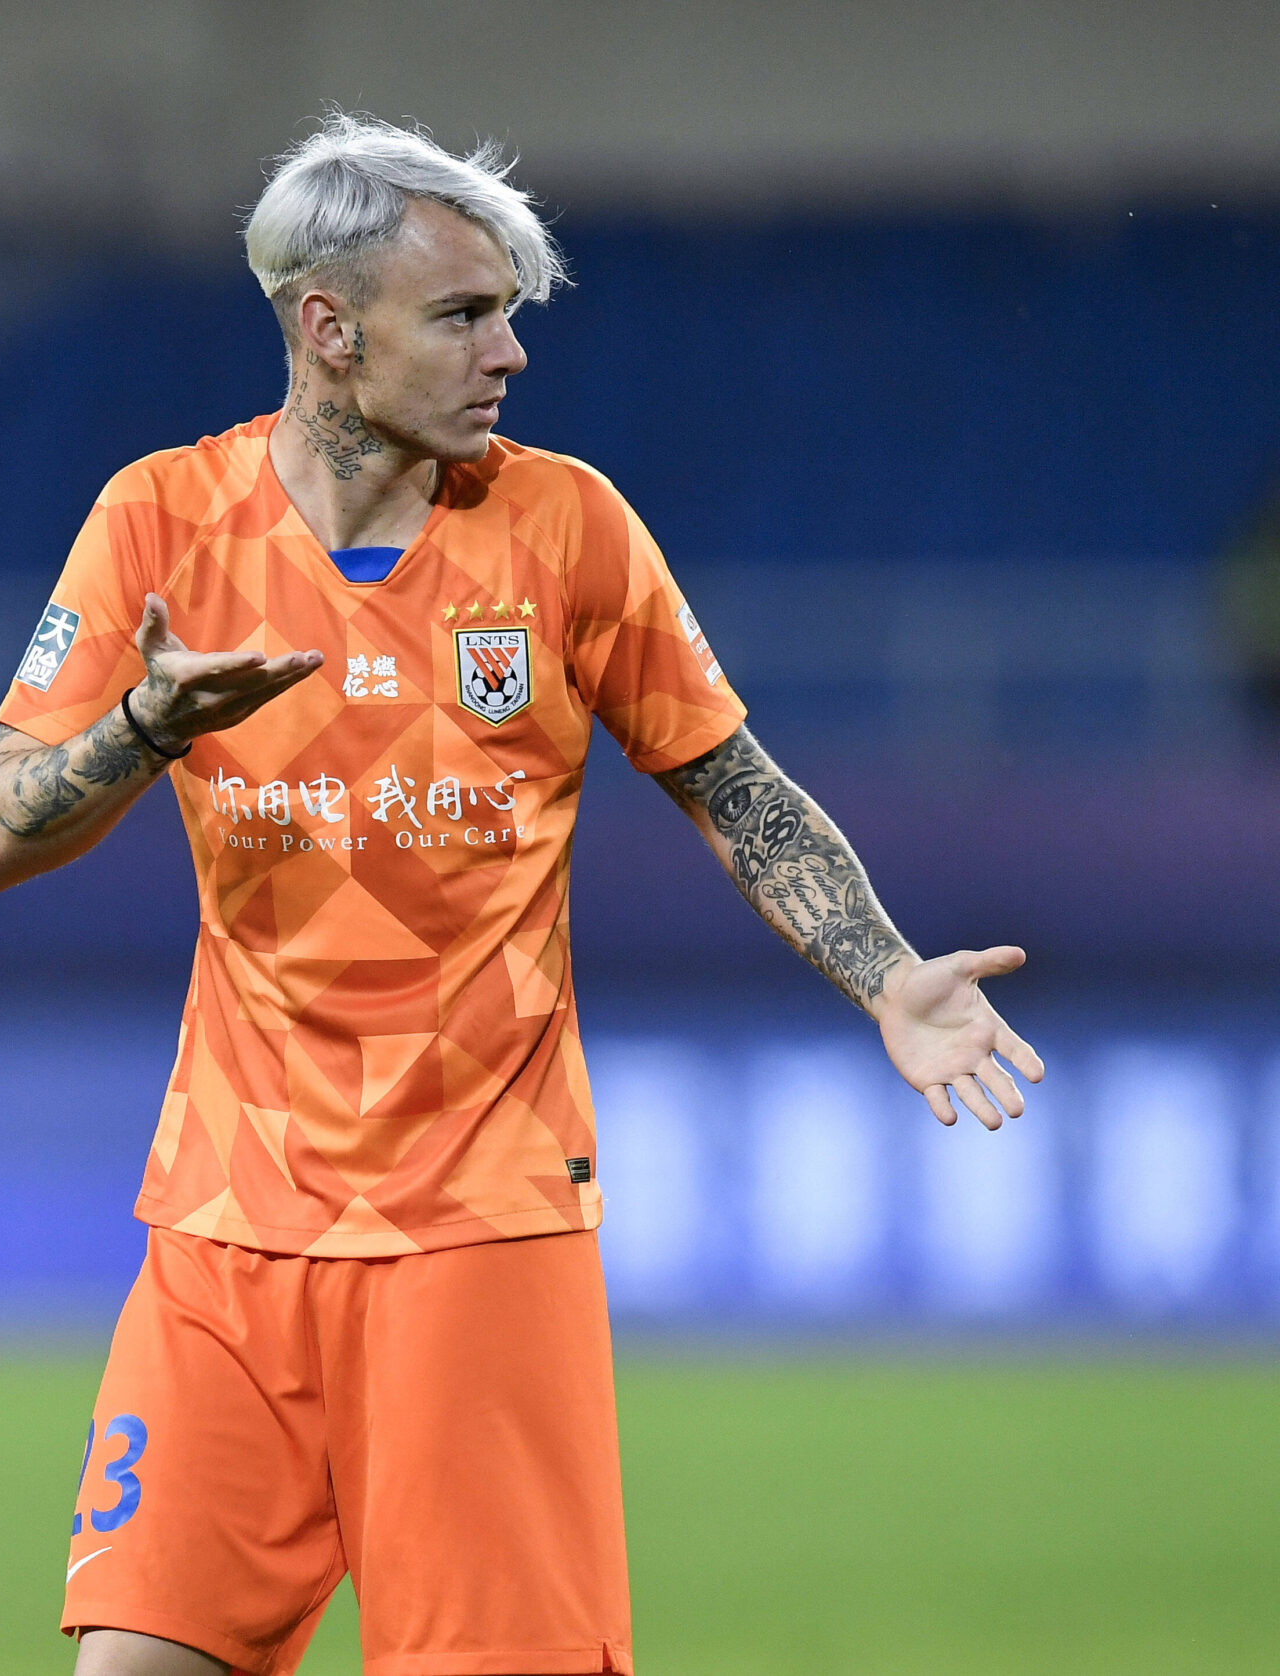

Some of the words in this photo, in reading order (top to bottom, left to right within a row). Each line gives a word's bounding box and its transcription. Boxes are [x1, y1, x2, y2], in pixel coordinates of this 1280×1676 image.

[465, 635, 520, 646] LNTS
[209, 766, 346, 826] 你用电
[366, 764, 526, 829] 我用心
[218, 827, 267, 850] Your
[280, 834, 368, 852] Power
[395, 830, 450, 849] Our
[464, 825, 525, 845] Care
[761, 881, 817, 938] Gabriel
[777, 864, 823, 921] Marisa
[72, 1413, 148, 1537] 3
